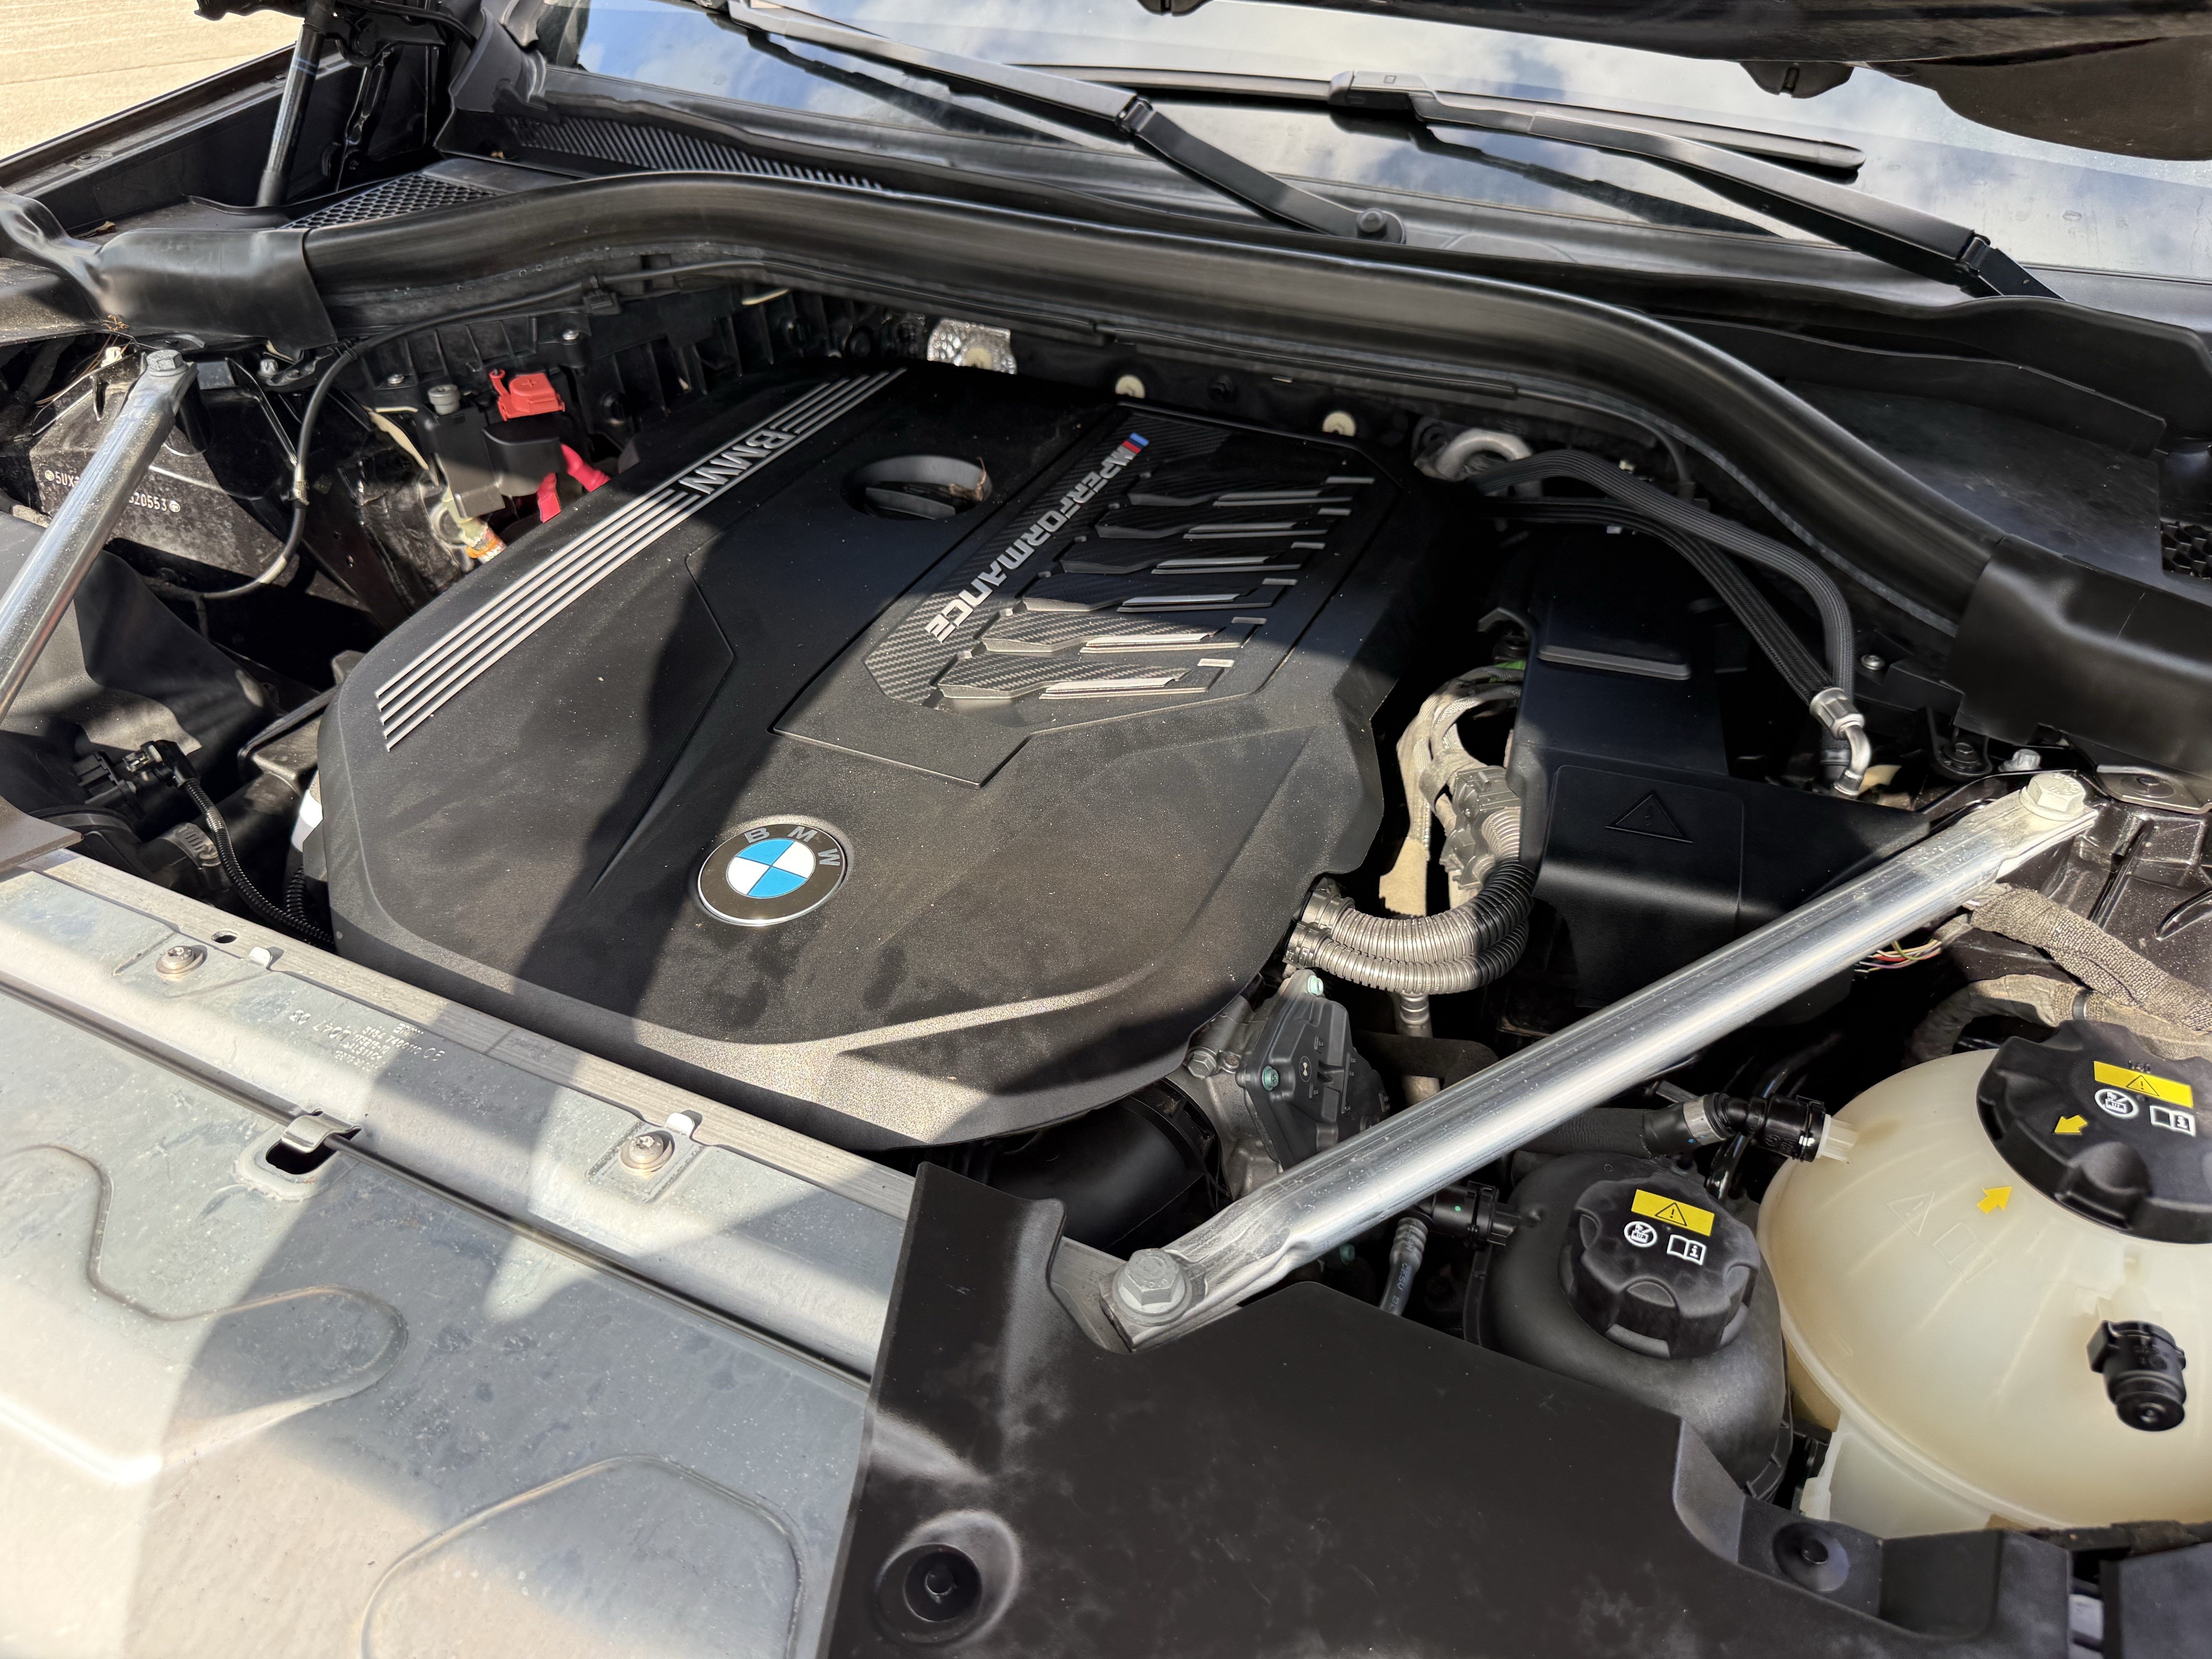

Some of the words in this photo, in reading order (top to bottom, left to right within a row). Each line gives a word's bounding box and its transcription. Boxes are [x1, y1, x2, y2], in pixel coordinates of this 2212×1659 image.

[678, 428, 797, 495] BMW
[924, 461, 1121, 643] PERFORMANCE
[744, 826, 841, 866] BMW
